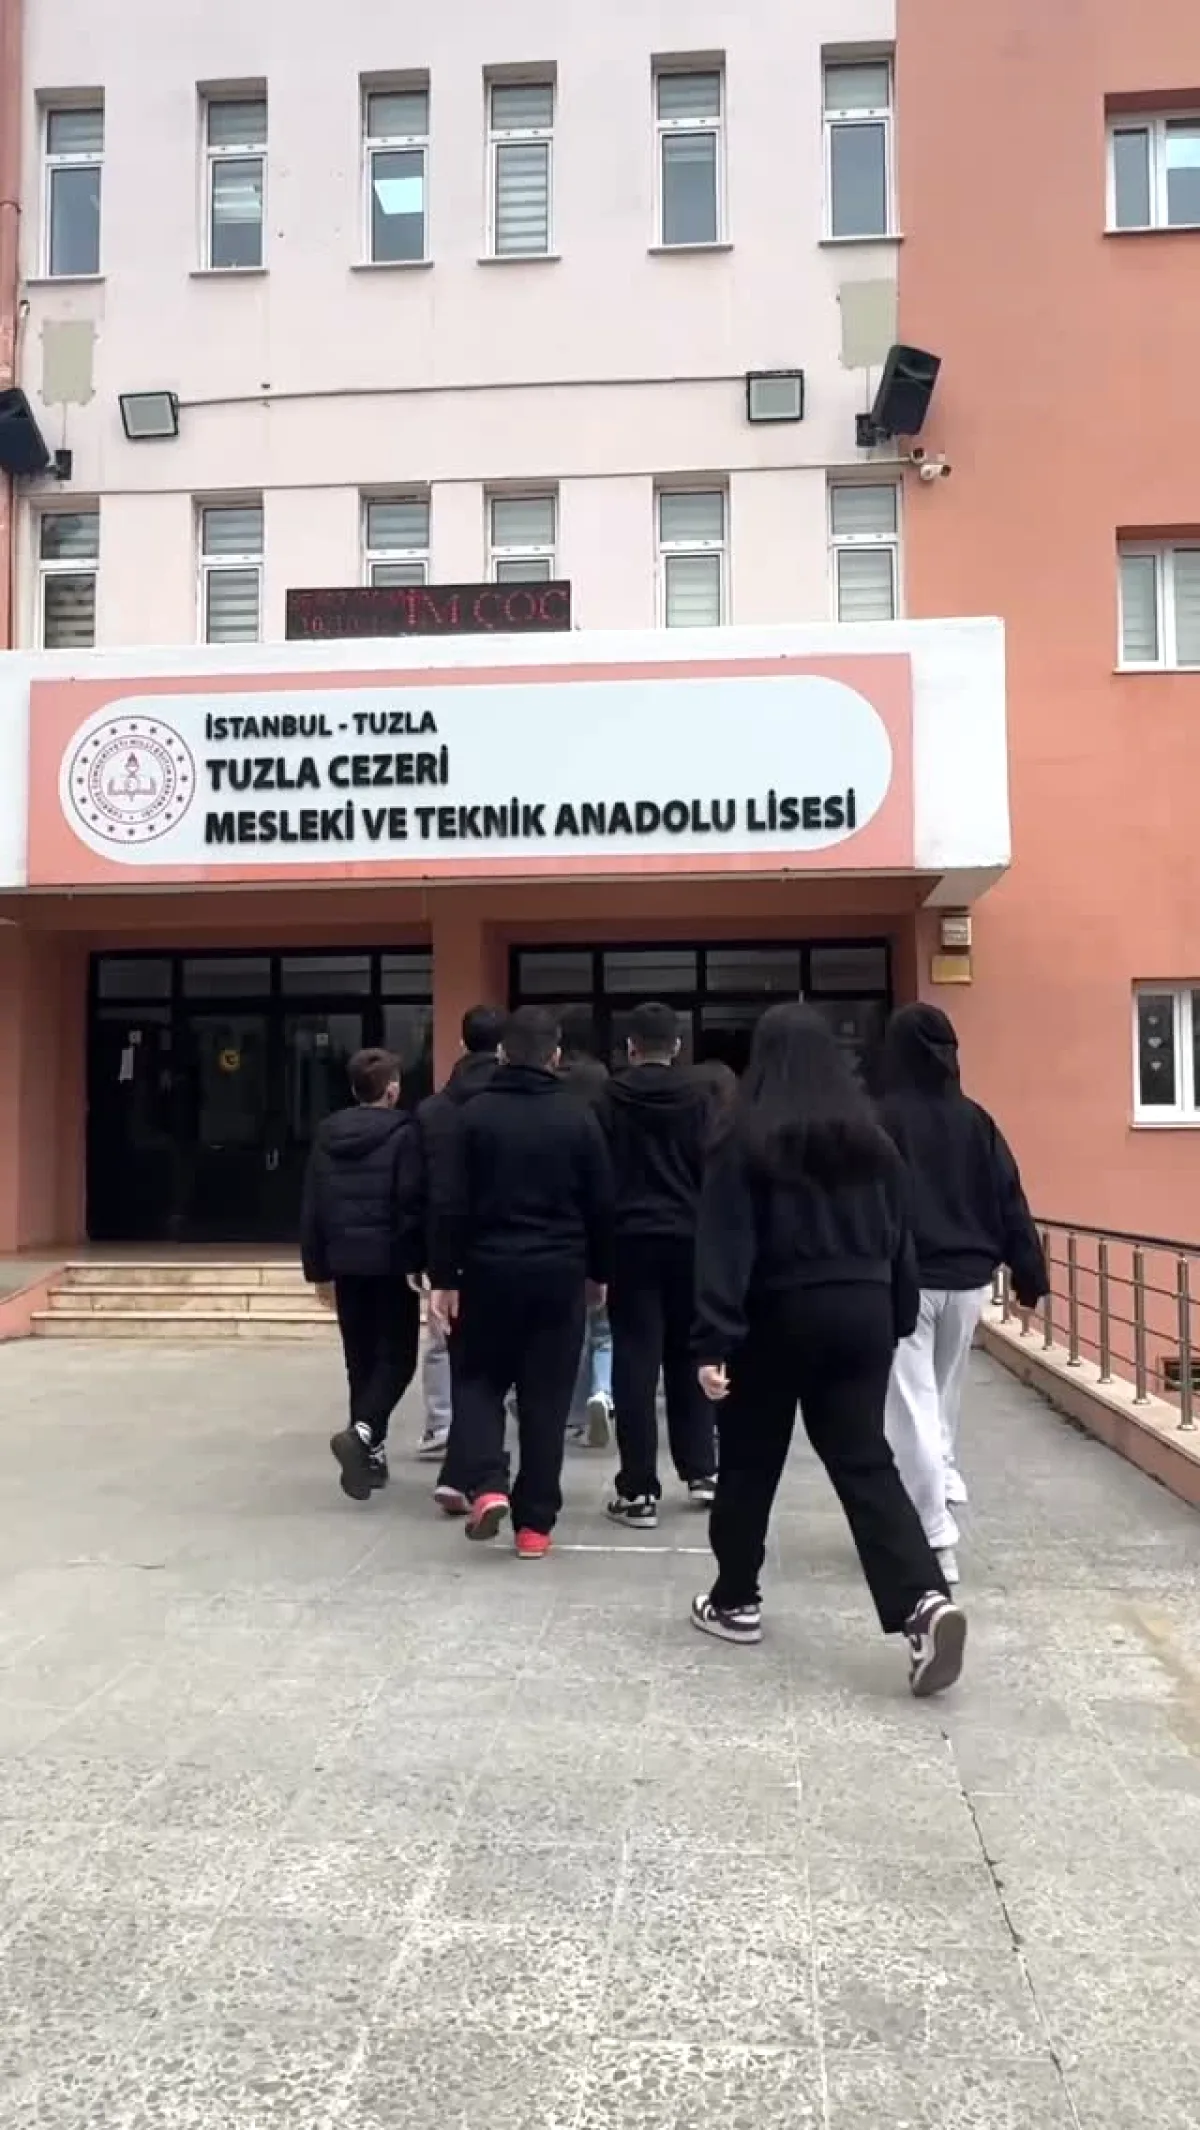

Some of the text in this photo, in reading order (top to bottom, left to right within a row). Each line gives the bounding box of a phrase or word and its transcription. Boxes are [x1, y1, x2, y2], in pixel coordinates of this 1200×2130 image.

[205, 713, 333, 740] İSTANBUL
[352, 711, 438, 736] TUZLA
[205, 757, 321, 792] TUZLA
[327, 744, 449, 789] CEZERİ
[205, 788, 856, 845] MESLEKİ VE TEKNİK ANADOLU LİSESİ
